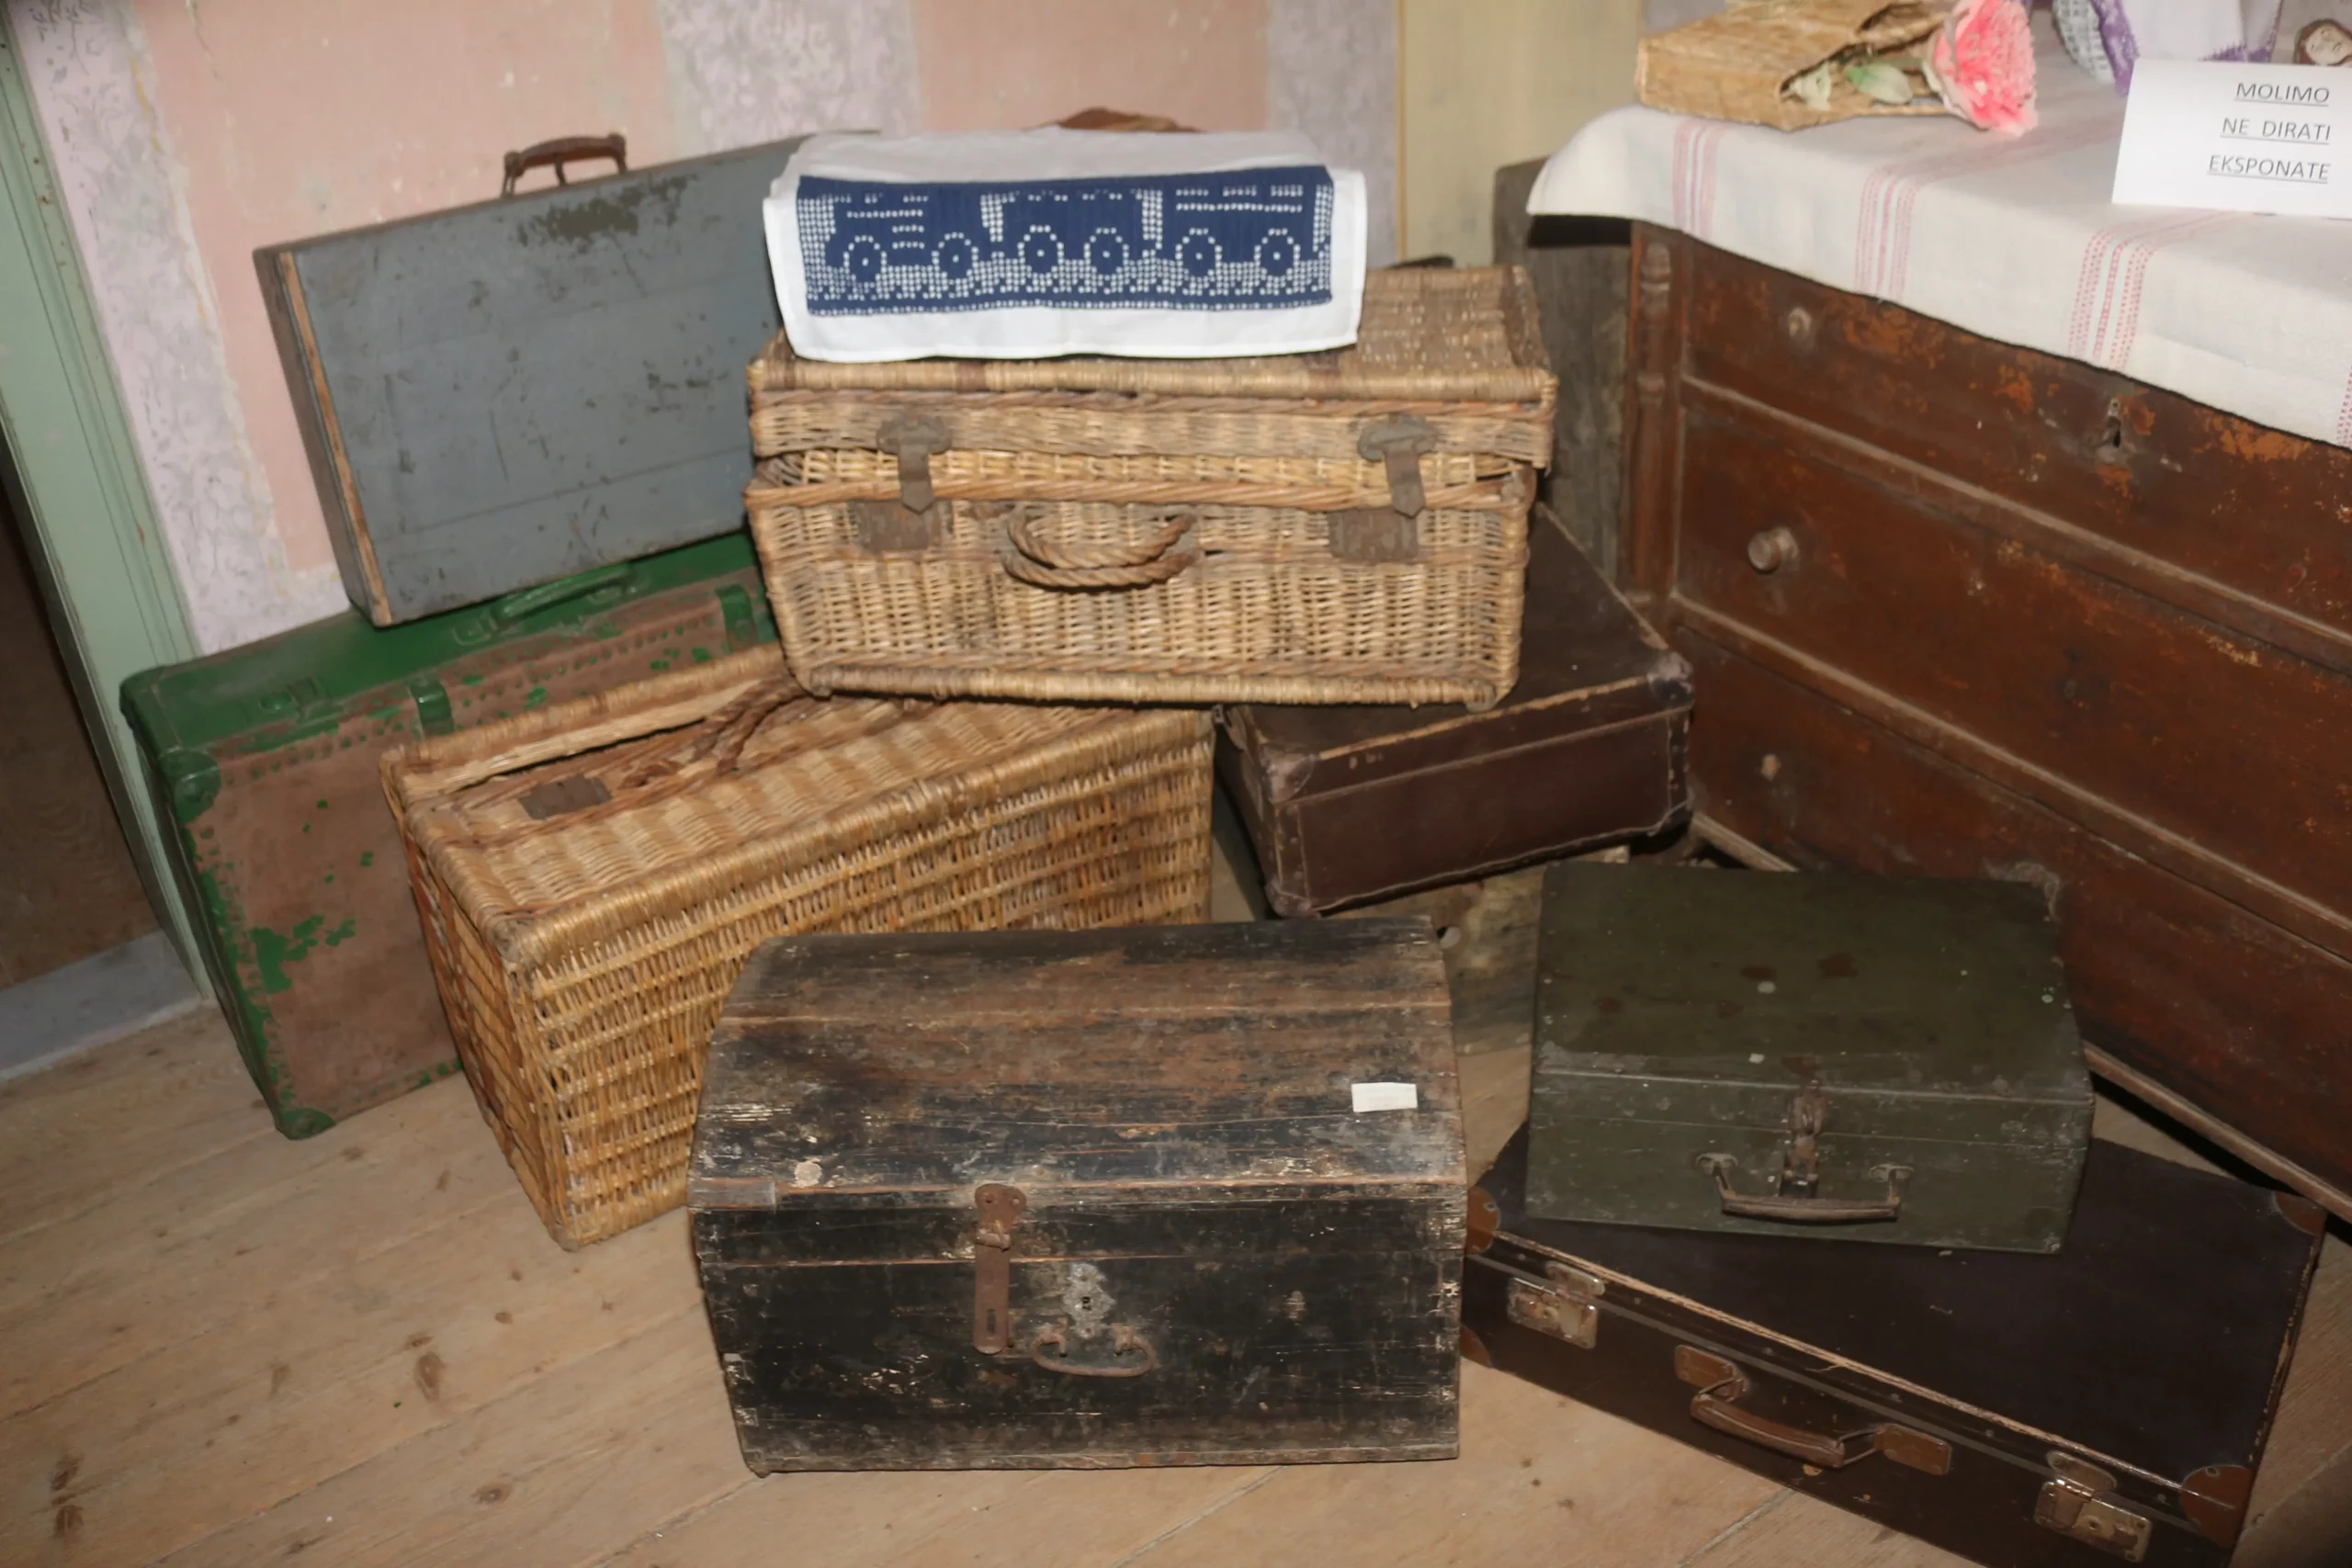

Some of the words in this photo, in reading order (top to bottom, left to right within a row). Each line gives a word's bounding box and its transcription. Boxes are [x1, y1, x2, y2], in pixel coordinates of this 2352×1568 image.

[2235, 83, 2330, 105] MOLIMO
[2222, 118, 2250, 136] NE
[2262, 119, 2331, 141] DIRATI
[2209, 154, 2331, 180] EKSPONATE
